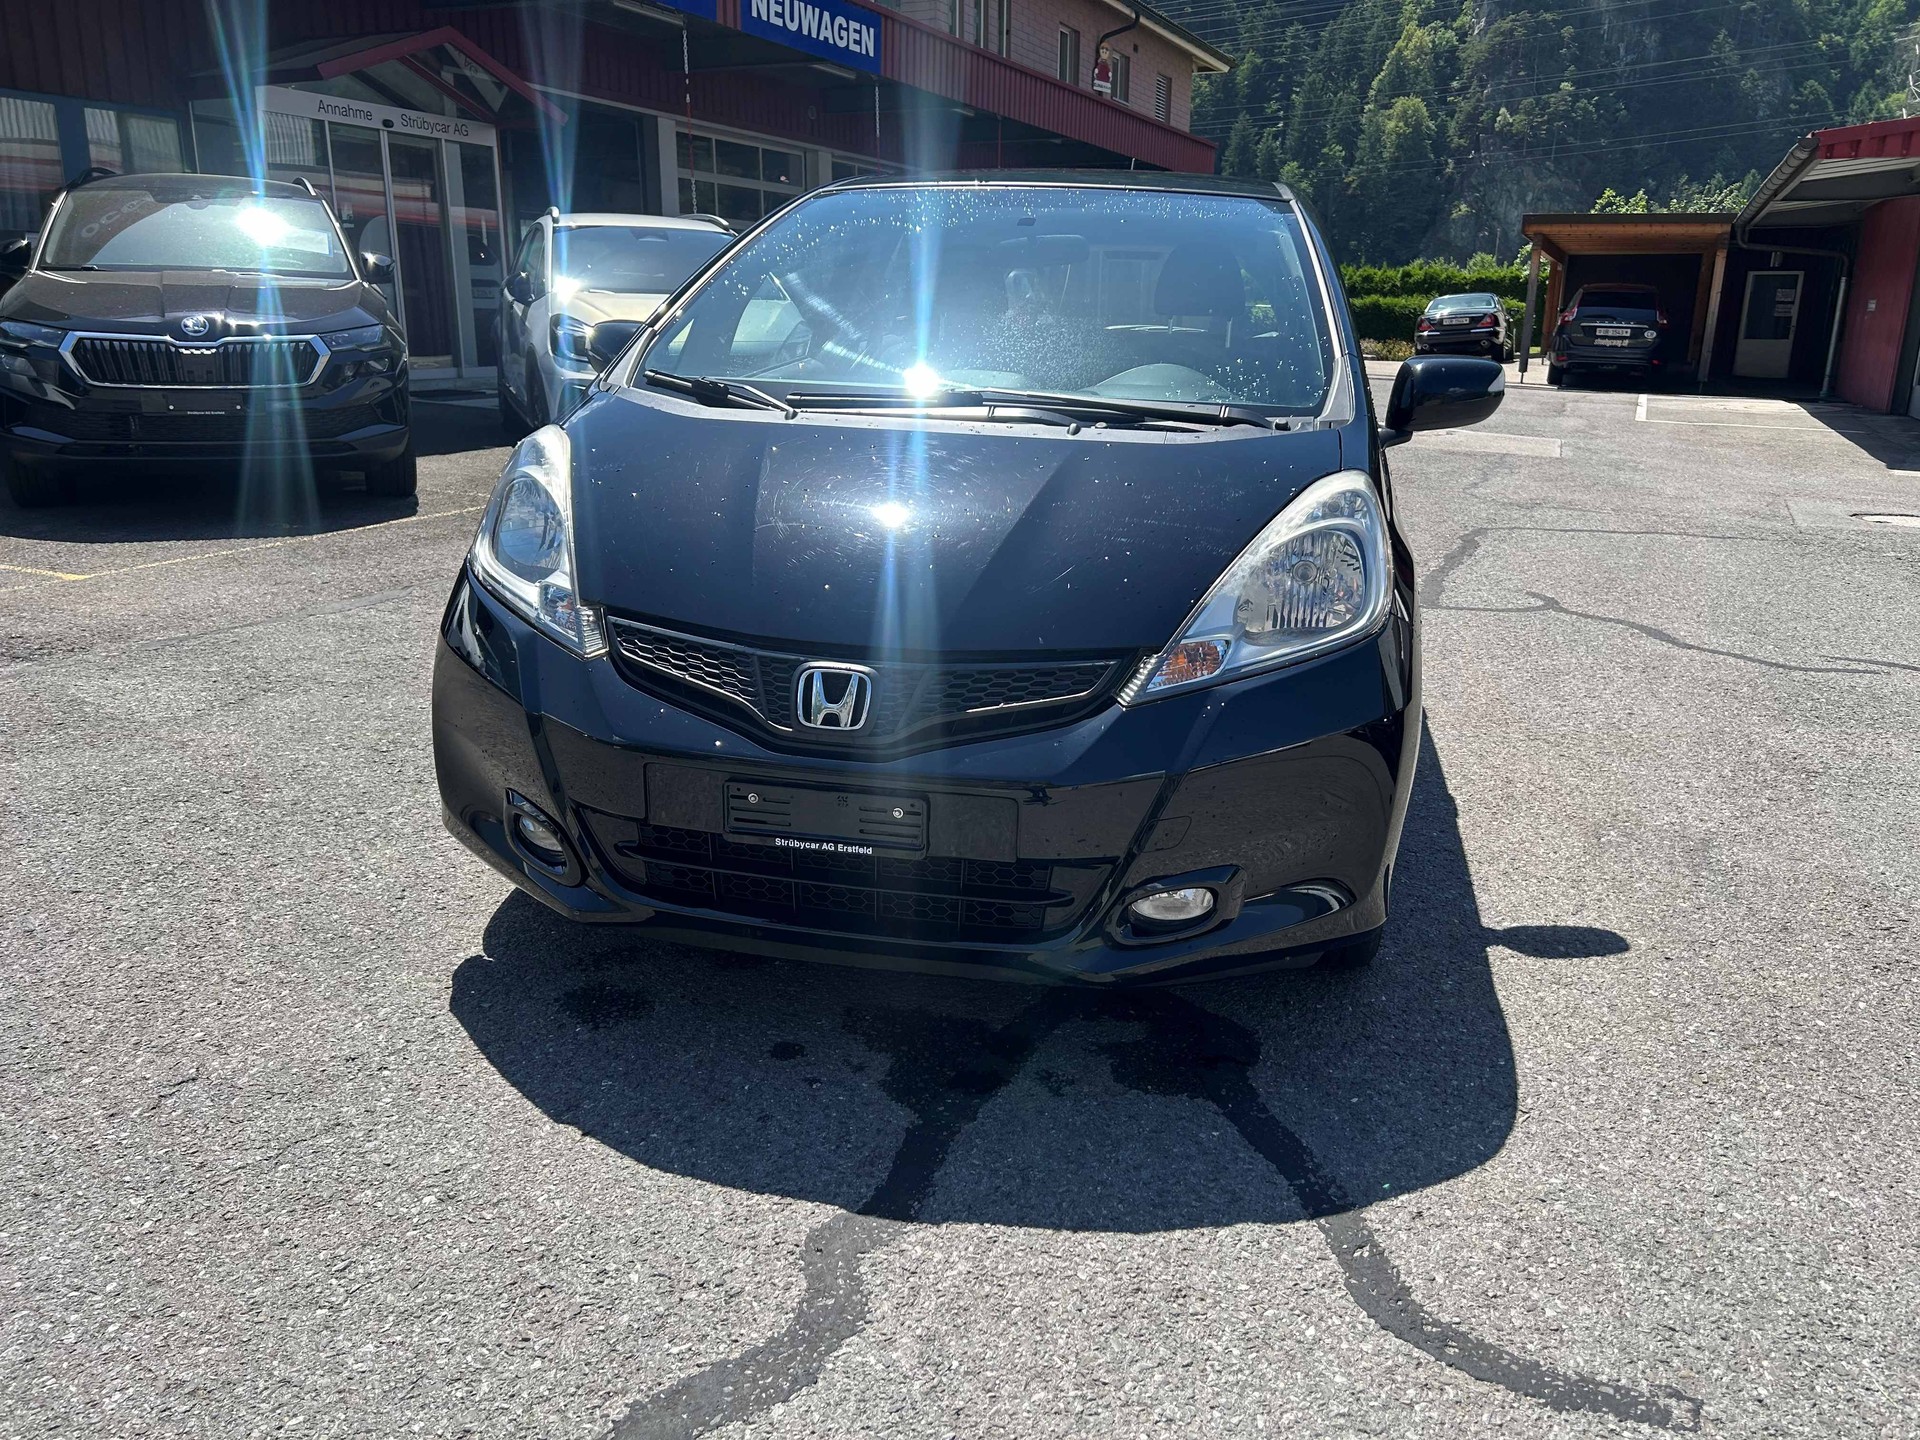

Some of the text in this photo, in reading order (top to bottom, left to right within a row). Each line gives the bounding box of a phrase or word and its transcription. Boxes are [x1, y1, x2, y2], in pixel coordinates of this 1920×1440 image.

[751, 0, 876, 58] NEUWAGEN
[317, 99, 469, 137] Annahme Strübycar AG
[775, 837, 873, 855] Strübycar AG Erstfeld
